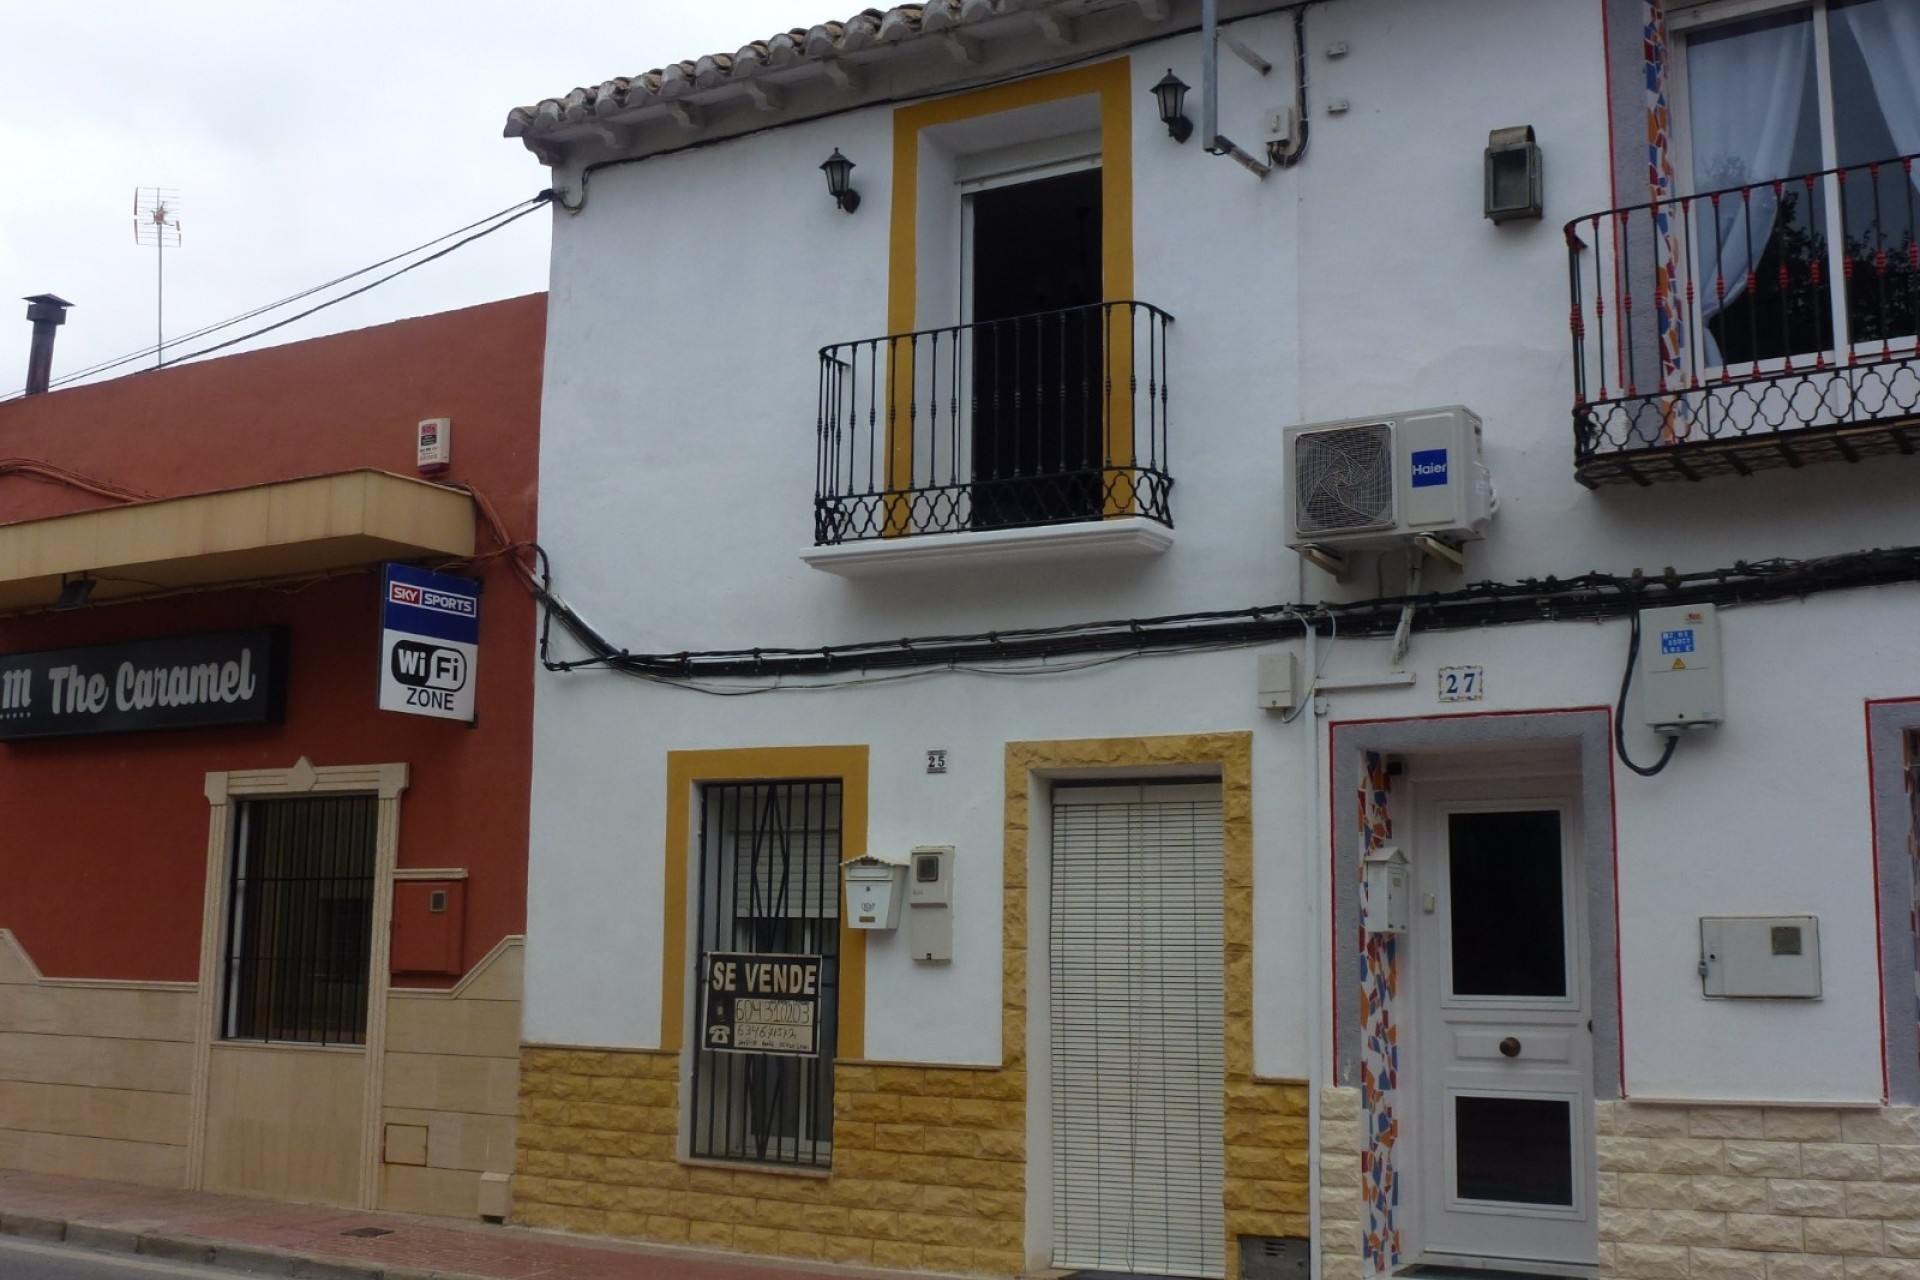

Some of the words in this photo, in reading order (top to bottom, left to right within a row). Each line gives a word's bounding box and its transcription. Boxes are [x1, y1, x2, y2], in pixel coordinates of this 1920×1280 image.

[1412, 462, 1447, 475] Haier
[394, 586, 419, 601] SKY
[424, 593, 472, 612] SPORTS
[48, 664, 109, 714] The
[115, 648, 256, 711] Caramel
[1446, 673, 1475, 694] 27
[406, 687, 455, 711] ZONE
[928, 755, 945, 768] 25
[712, 961, 737, 991] SE
[744, 963, 817, 995] VENDE
